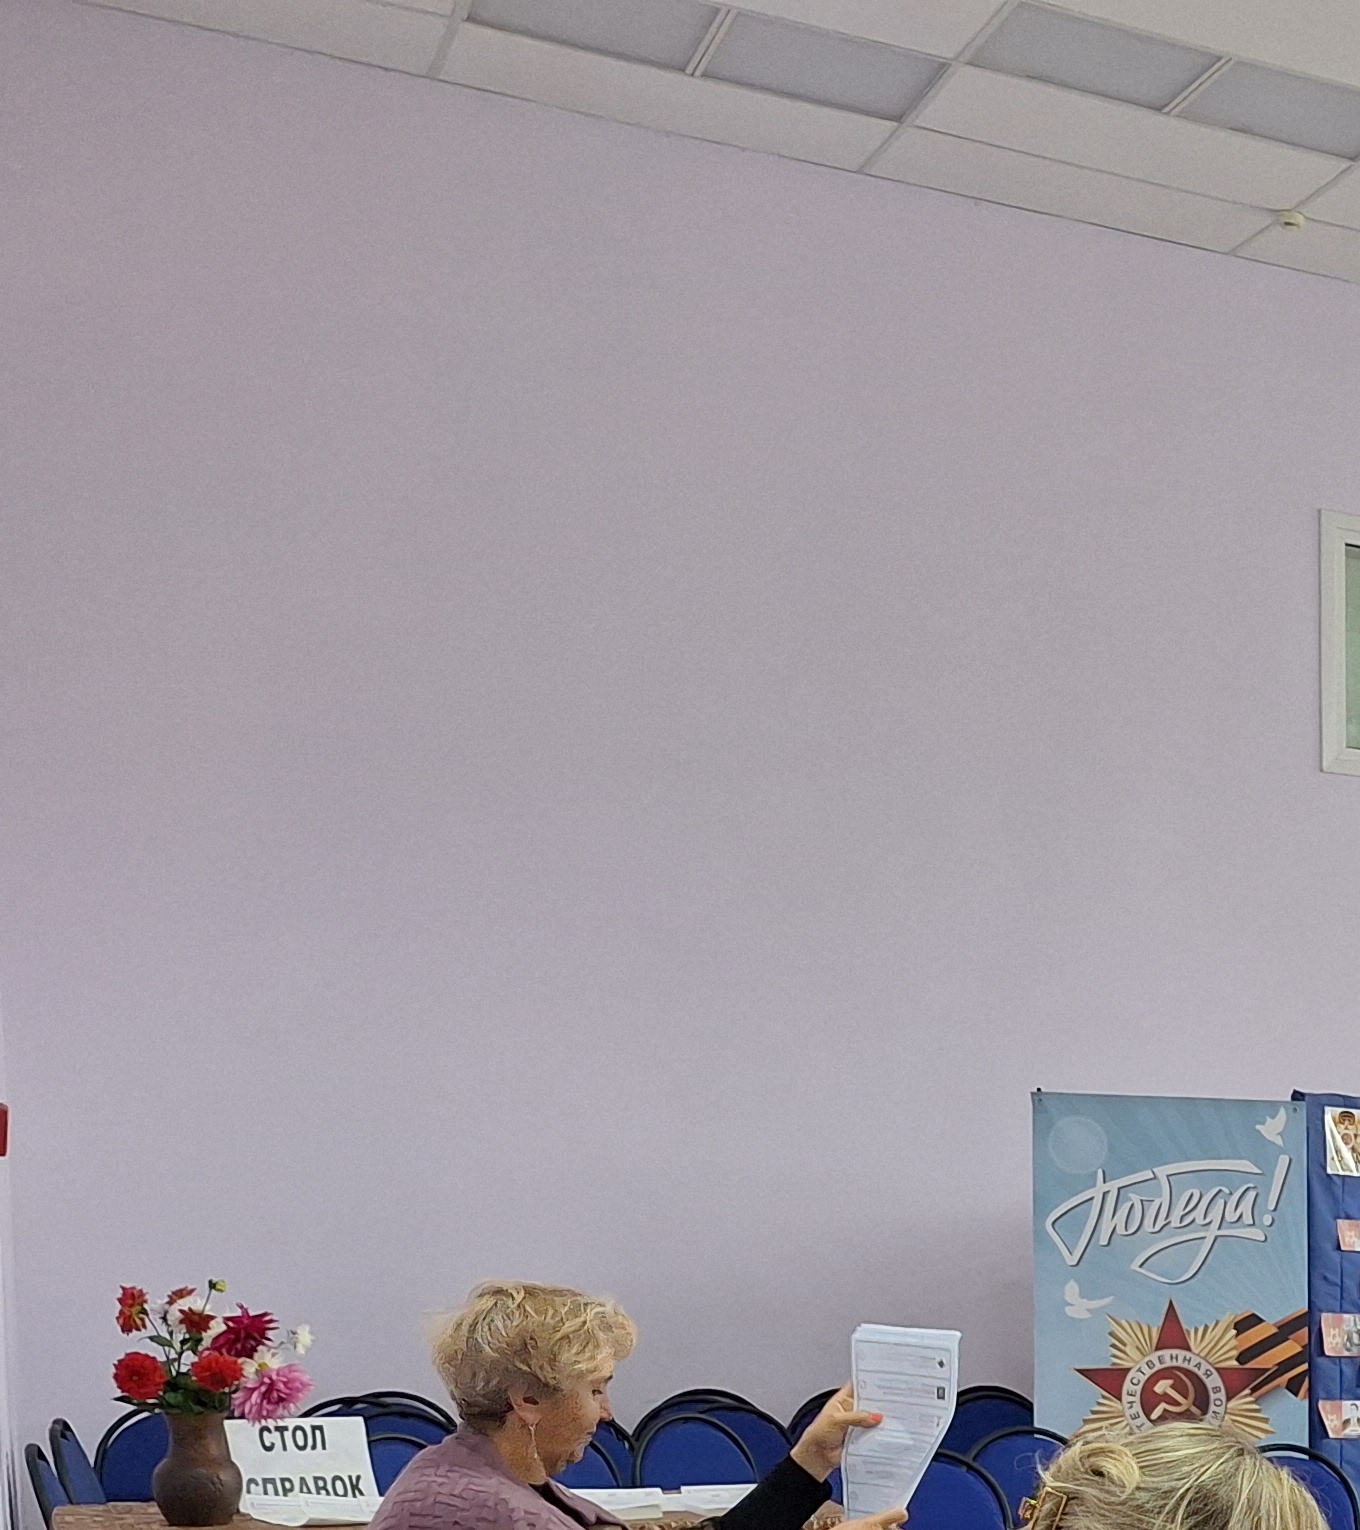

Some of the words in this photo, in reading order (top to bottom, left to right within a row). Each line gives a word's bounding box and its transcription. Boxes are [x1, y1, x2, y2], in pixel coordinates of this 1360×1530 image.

[1045, 1153, 1292, 1285] Победа!
[1126, 1353, 1214, 1432] ТЕЧЕСТВЕННАЯ
[258, 1424, 327, 1452] СТОЛ
[245, 1474, 366, 1499] СПРАВОК
